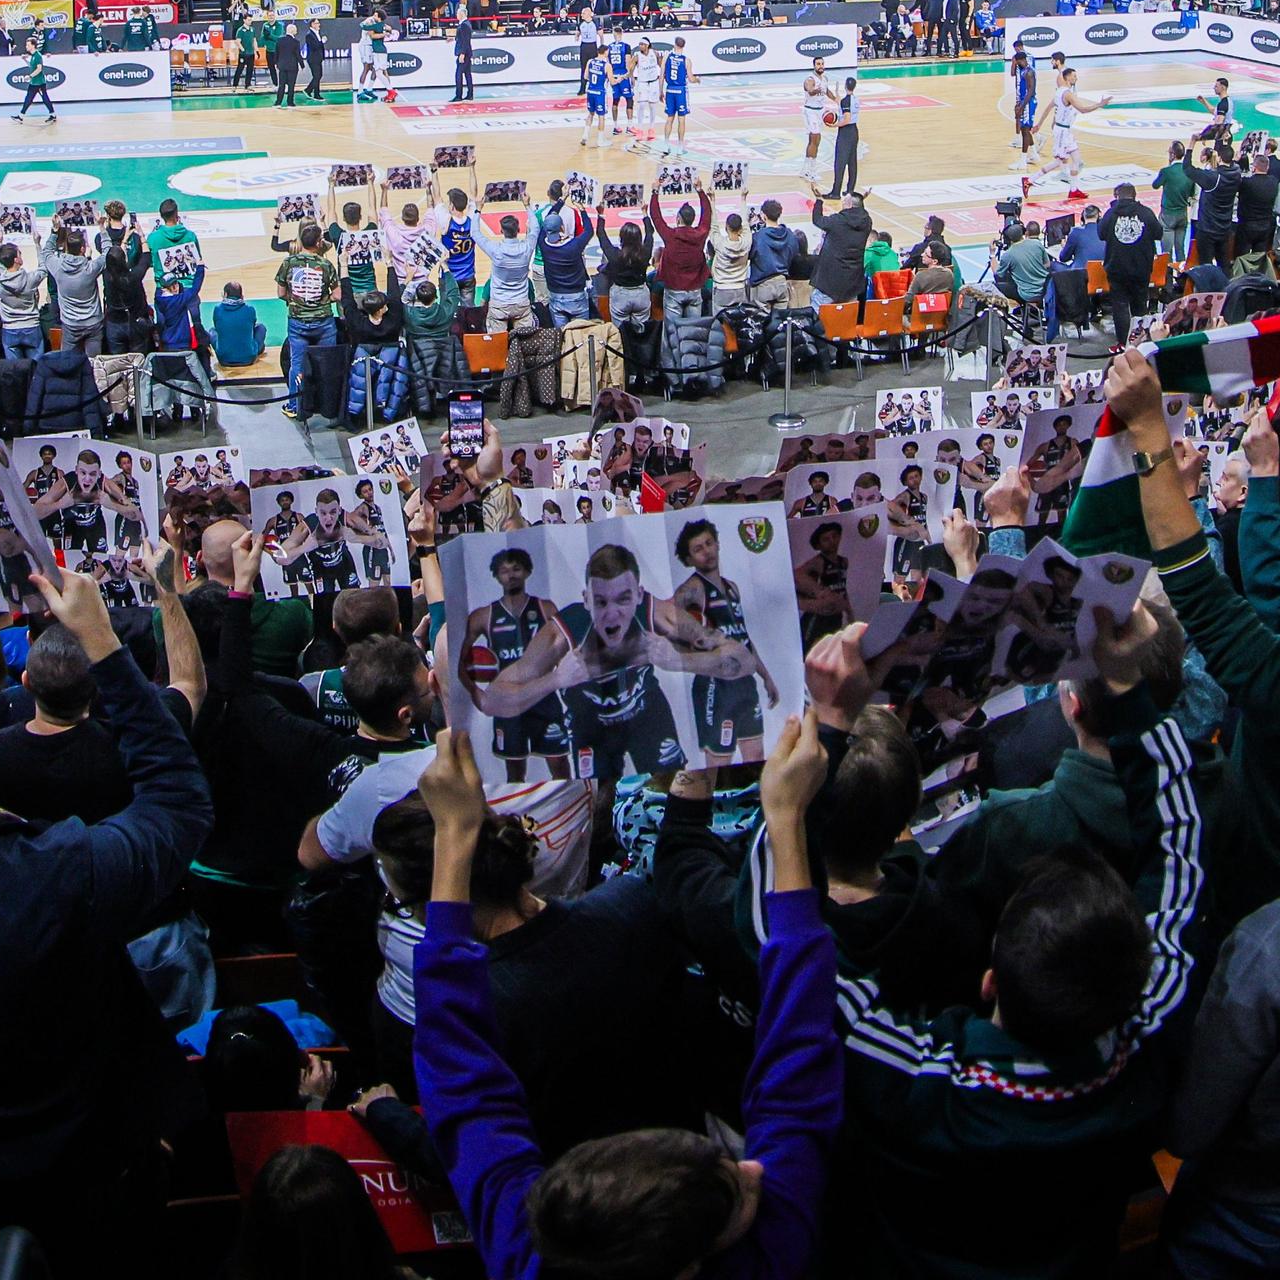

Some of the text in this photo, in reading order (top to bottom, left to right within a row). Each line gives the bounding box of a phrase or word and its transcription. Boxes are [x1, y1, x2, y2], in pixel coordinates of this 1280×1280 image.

[103, 10, 124, 21] LEN
[276, 5, 327, 17] LOTTO LOTTO
[46, 15, 64, 25] LOTTO
[1021, 31, 1056, 41] enel-med
[1089, 29, 1124, 39] enel-med
[800, 41, 839, 51] enel-med
[1253, 36, 1280, 48] enel-med
[717, 44, 761, 55] enel-med
[471, 55, 509, 66] nel-med
[551, 53, 581, 62] enel-
[610, 54, 622, 65] 23
[104, 70, 148, 80] enel-med
[591, 74, 598, 84] 0
[670, 69, 678, 80] 5
[450, 238, 472, 254] 30
